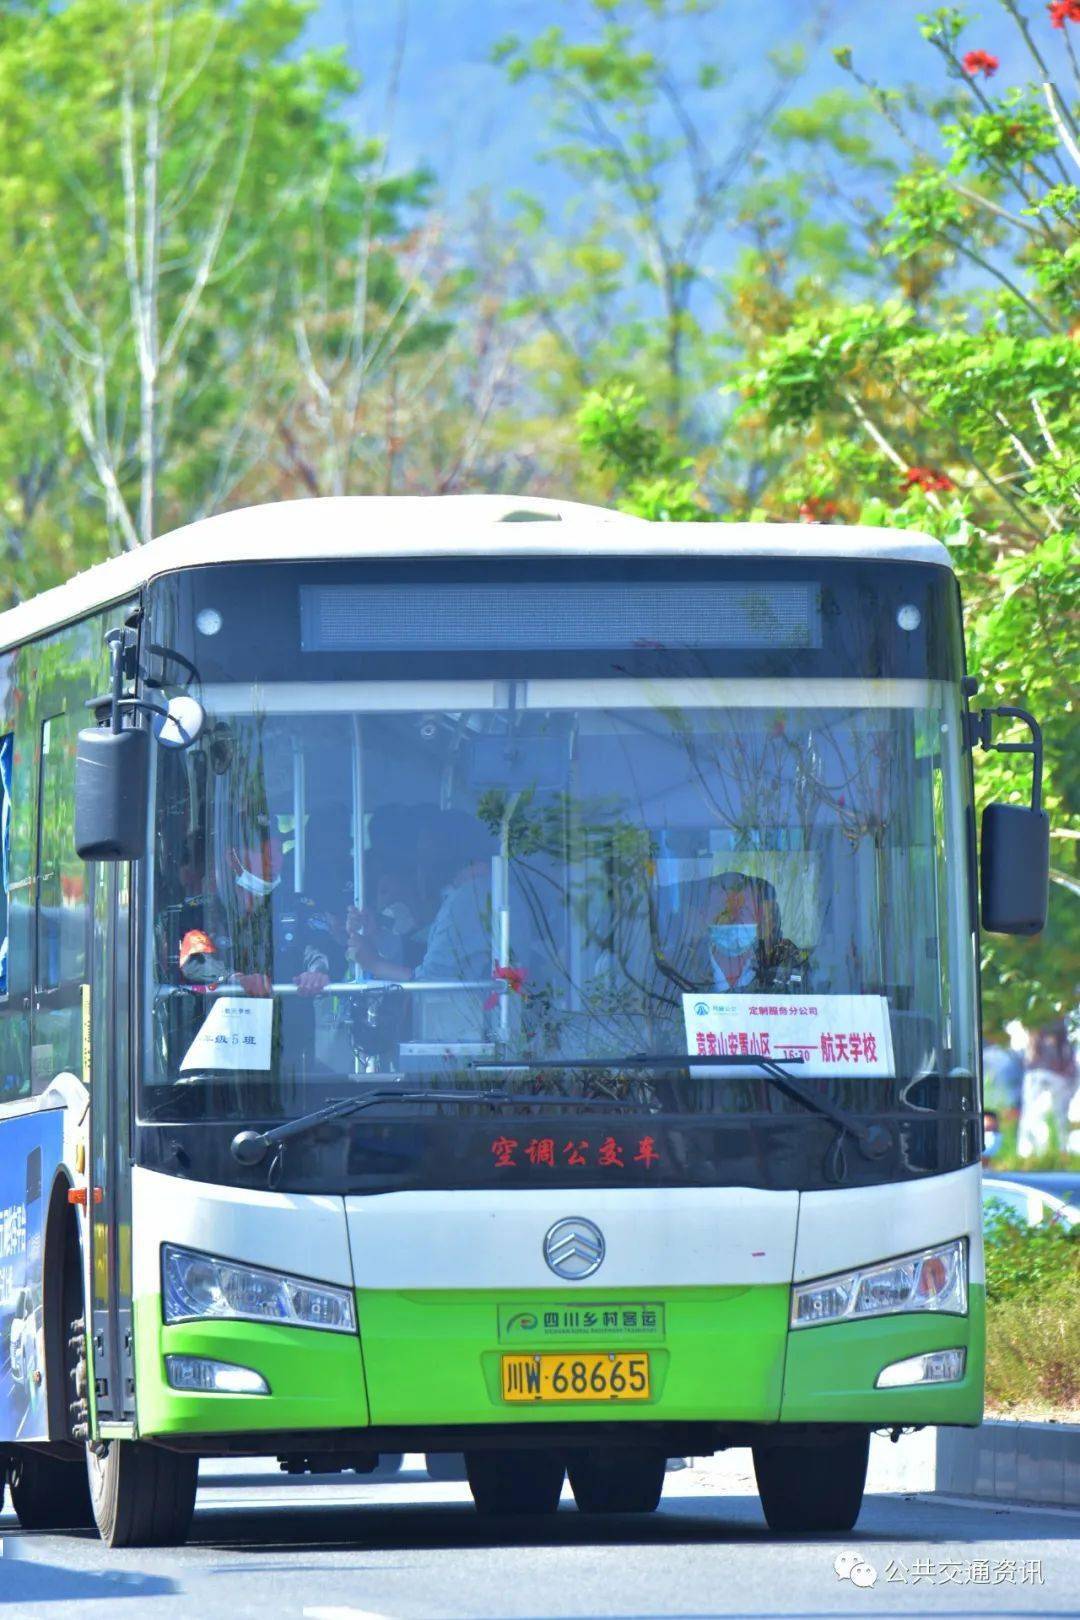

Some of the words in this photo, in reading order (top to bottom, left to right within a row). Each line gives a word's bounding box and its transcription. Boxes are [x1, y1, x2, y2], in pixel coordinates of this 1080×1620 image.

[748, 1006, 818, 1016] 定制服务分公司
[820, 1032, 878, 1063] 航天学校
[491, 1135, 660, 1168] 空调公交车
[543, 1311, 657, 1328] 四川乡村客运
